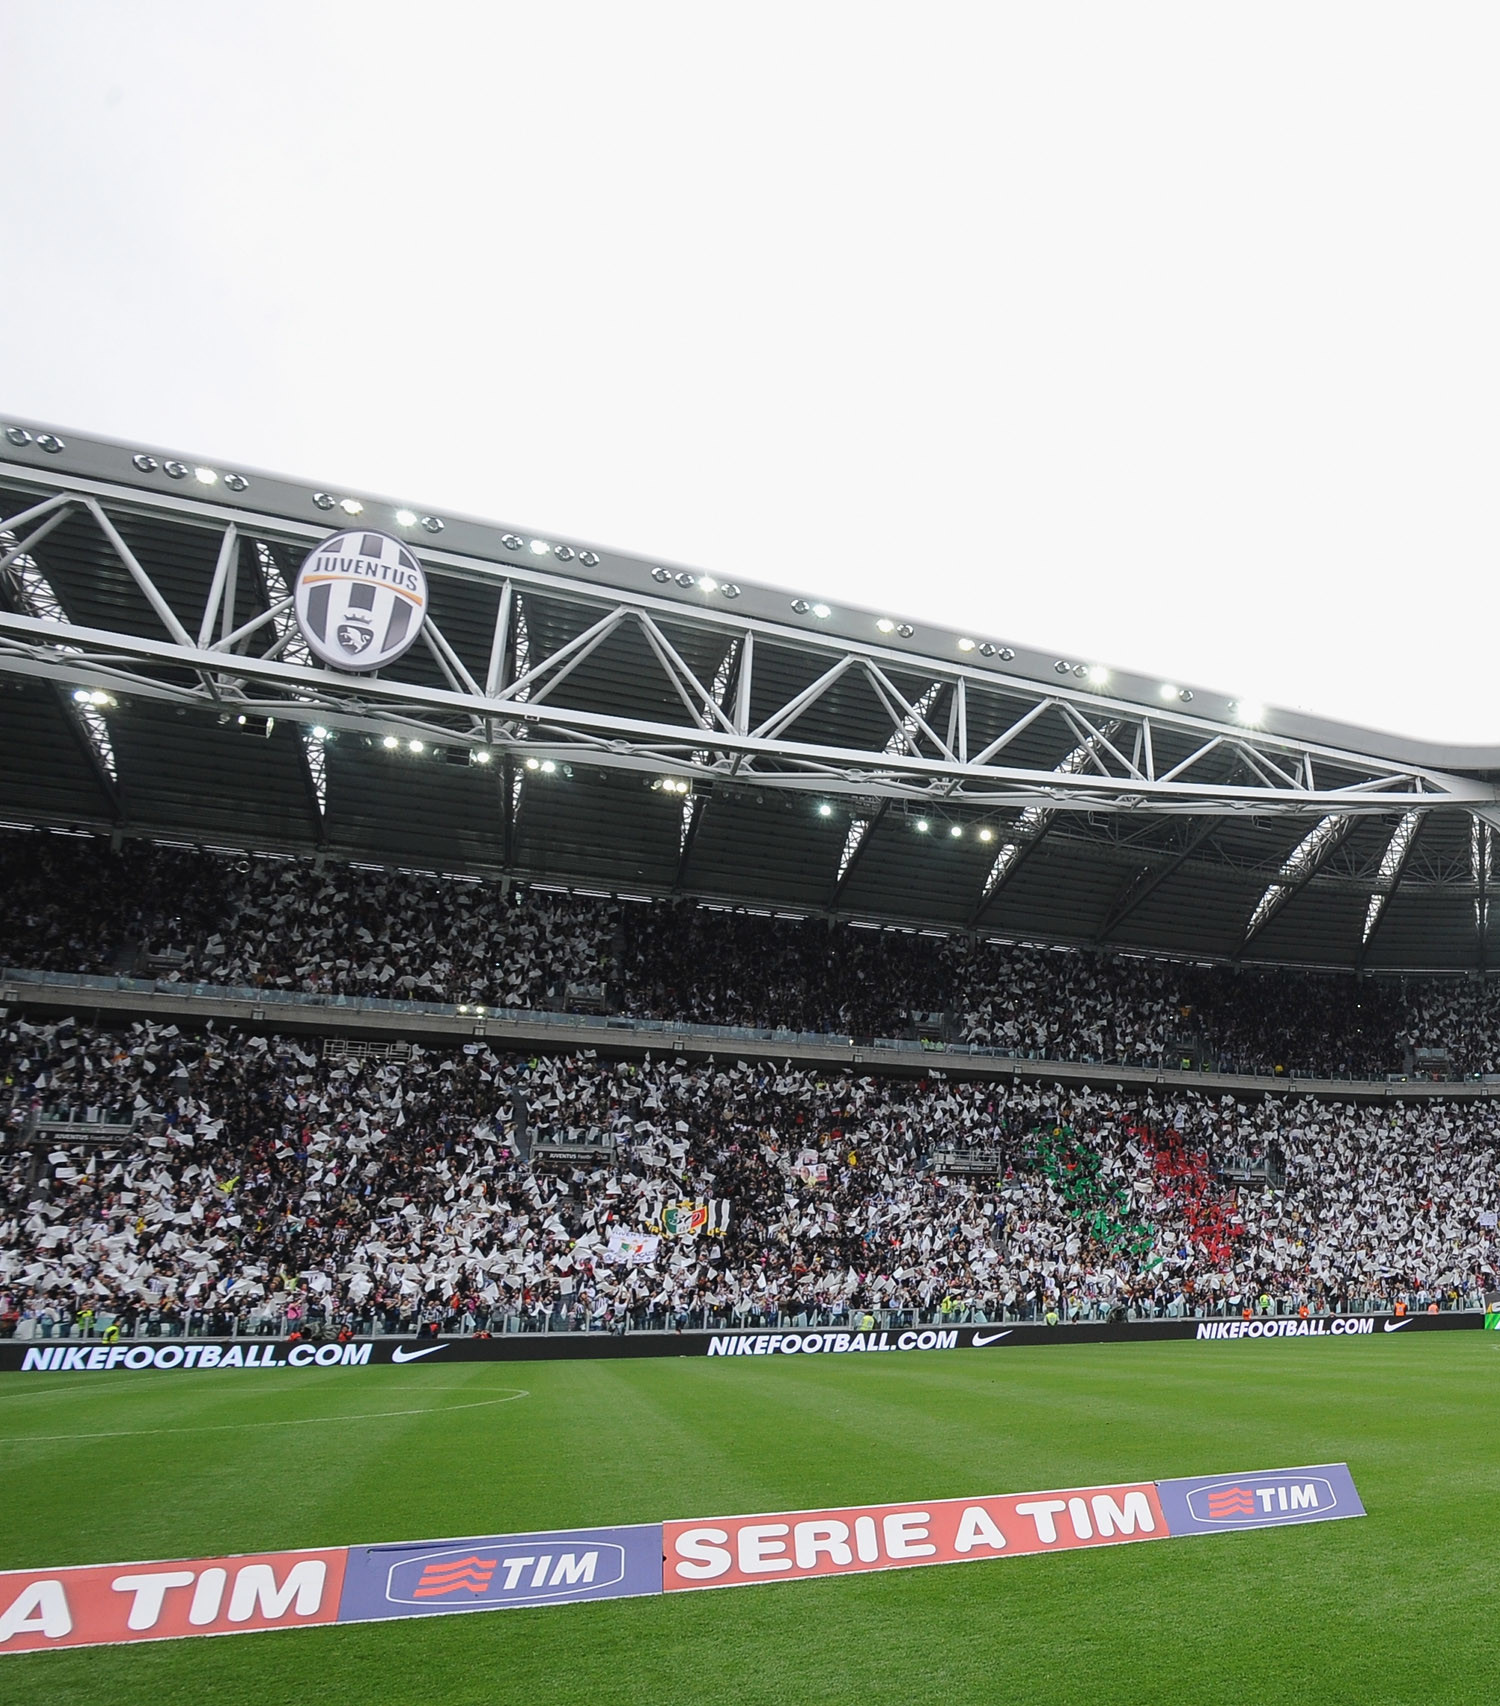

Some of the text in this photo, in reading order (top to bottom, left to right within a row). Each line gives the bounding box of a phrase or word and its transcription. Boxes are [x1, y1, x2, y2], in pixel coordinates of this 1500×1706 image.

[313, 557, 418, 592] JUVENTUS
[707, 1330, 958, 1357] NIKEFOOTBALL.COM
[1196, 1318, 1375, 1341] NIKEFOOTBALL.COM
[21, 1343, 373, 1371] NIKEFOOTBALL.COM
[1255, 1482, 1320, 1512] TIM
[674, 1491, 1156, 1581] SERIE A TIM
[502, 1552, 599, 1592] TIM
[0, 1560, 327, 1643] A TIM
